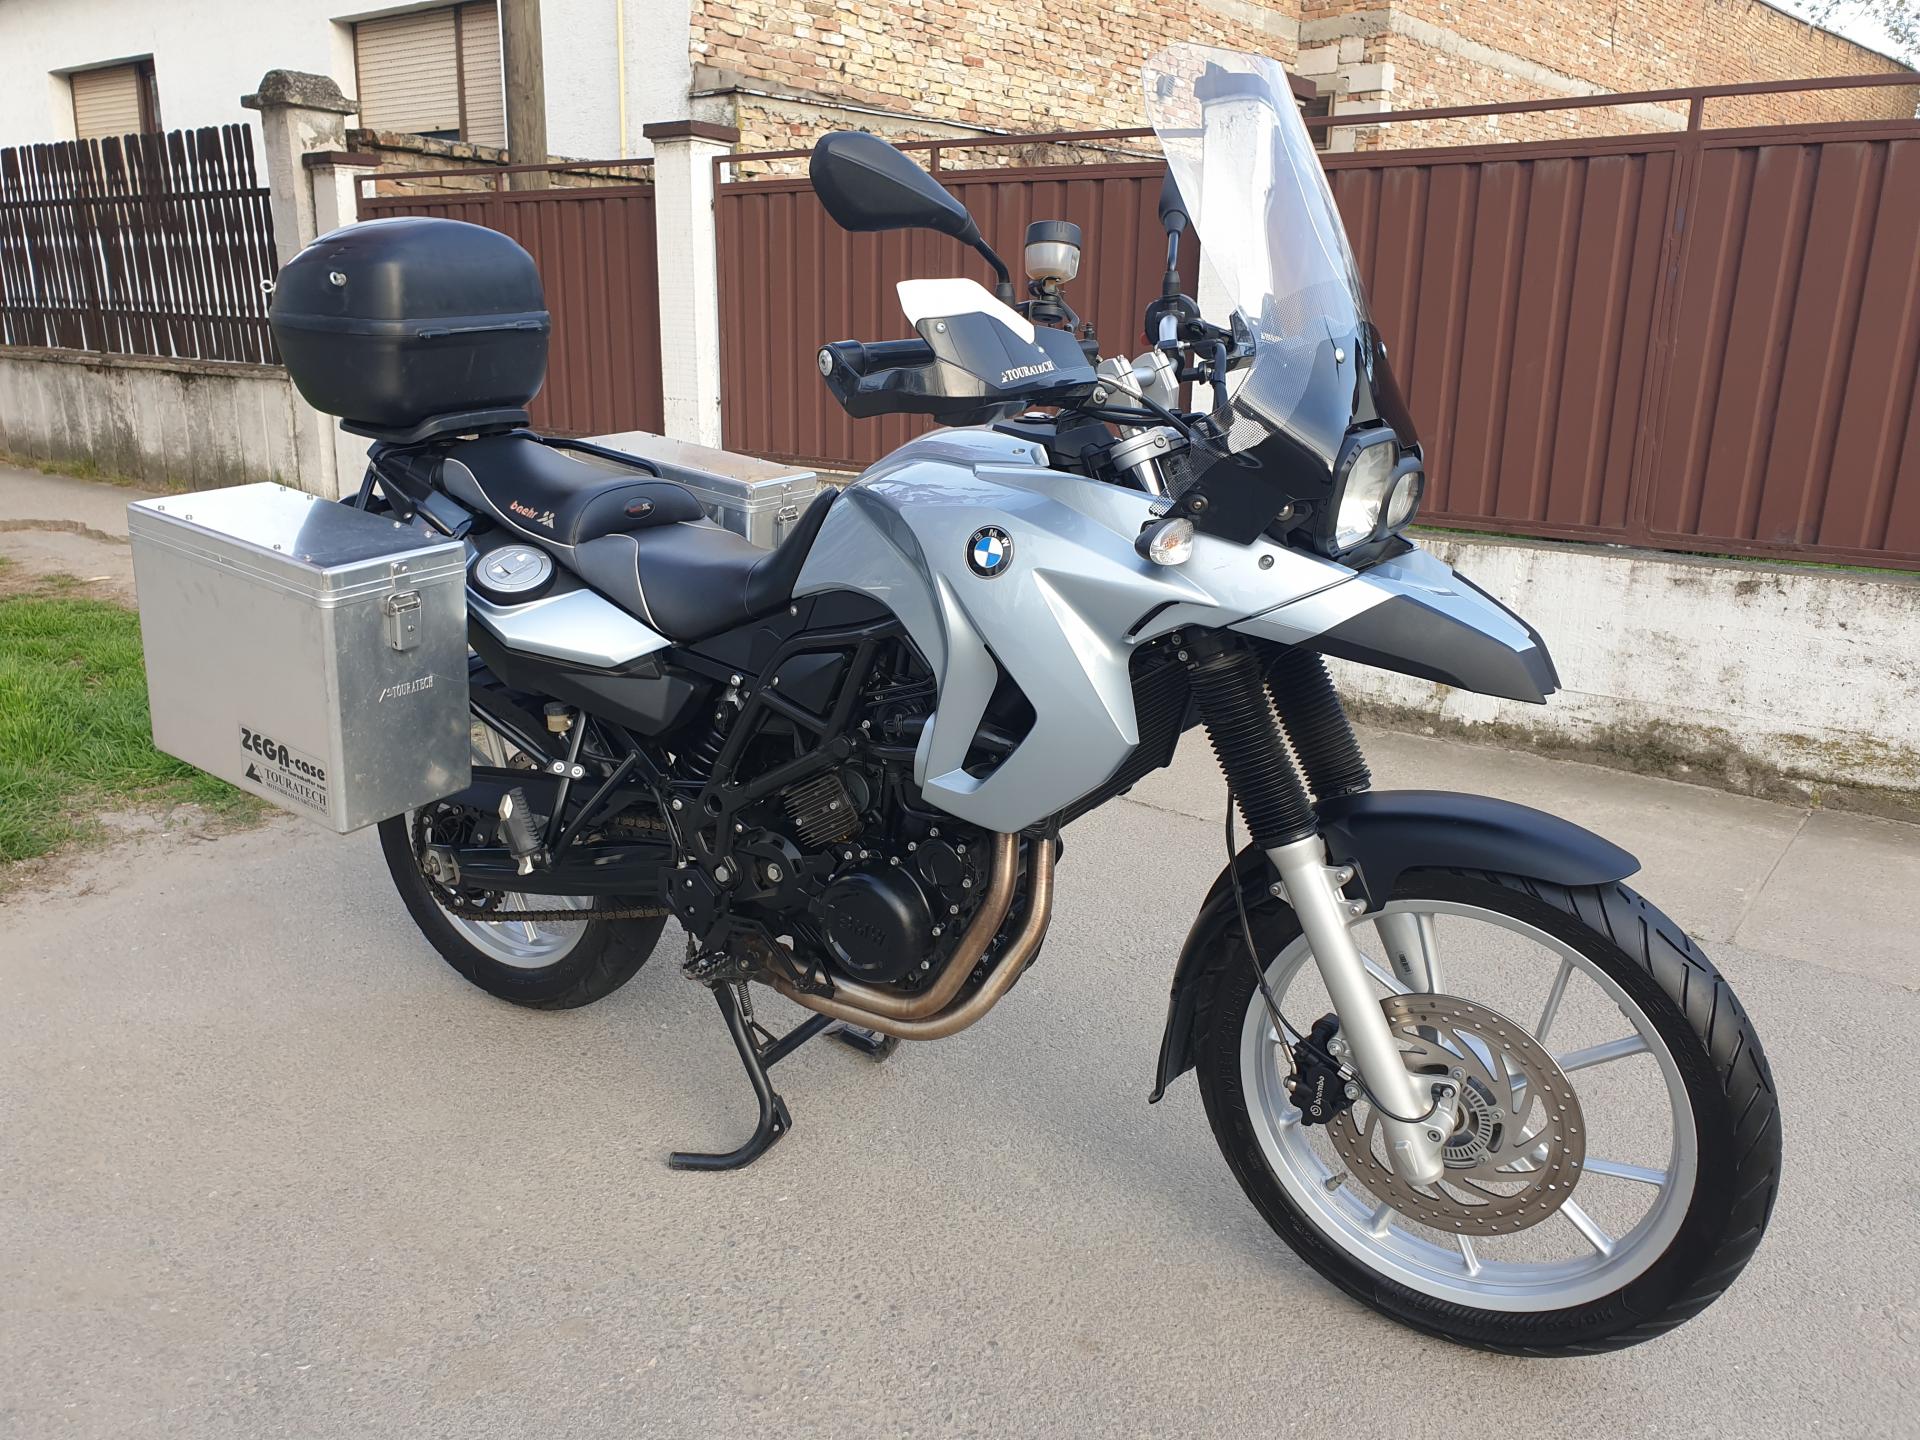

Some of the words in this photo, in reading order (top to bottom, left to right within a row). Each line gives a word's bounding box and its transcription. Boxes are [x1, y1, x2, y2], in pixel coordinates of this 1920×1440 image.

[510, 500, 538, 519] baehr
[974, 529, 1011, 547] BMW
[392, 675, 434, 698] TOURATECH
[265, 768, 327, 806] TOURATECH
[1313, 1075, 1325, 1105] brembo
